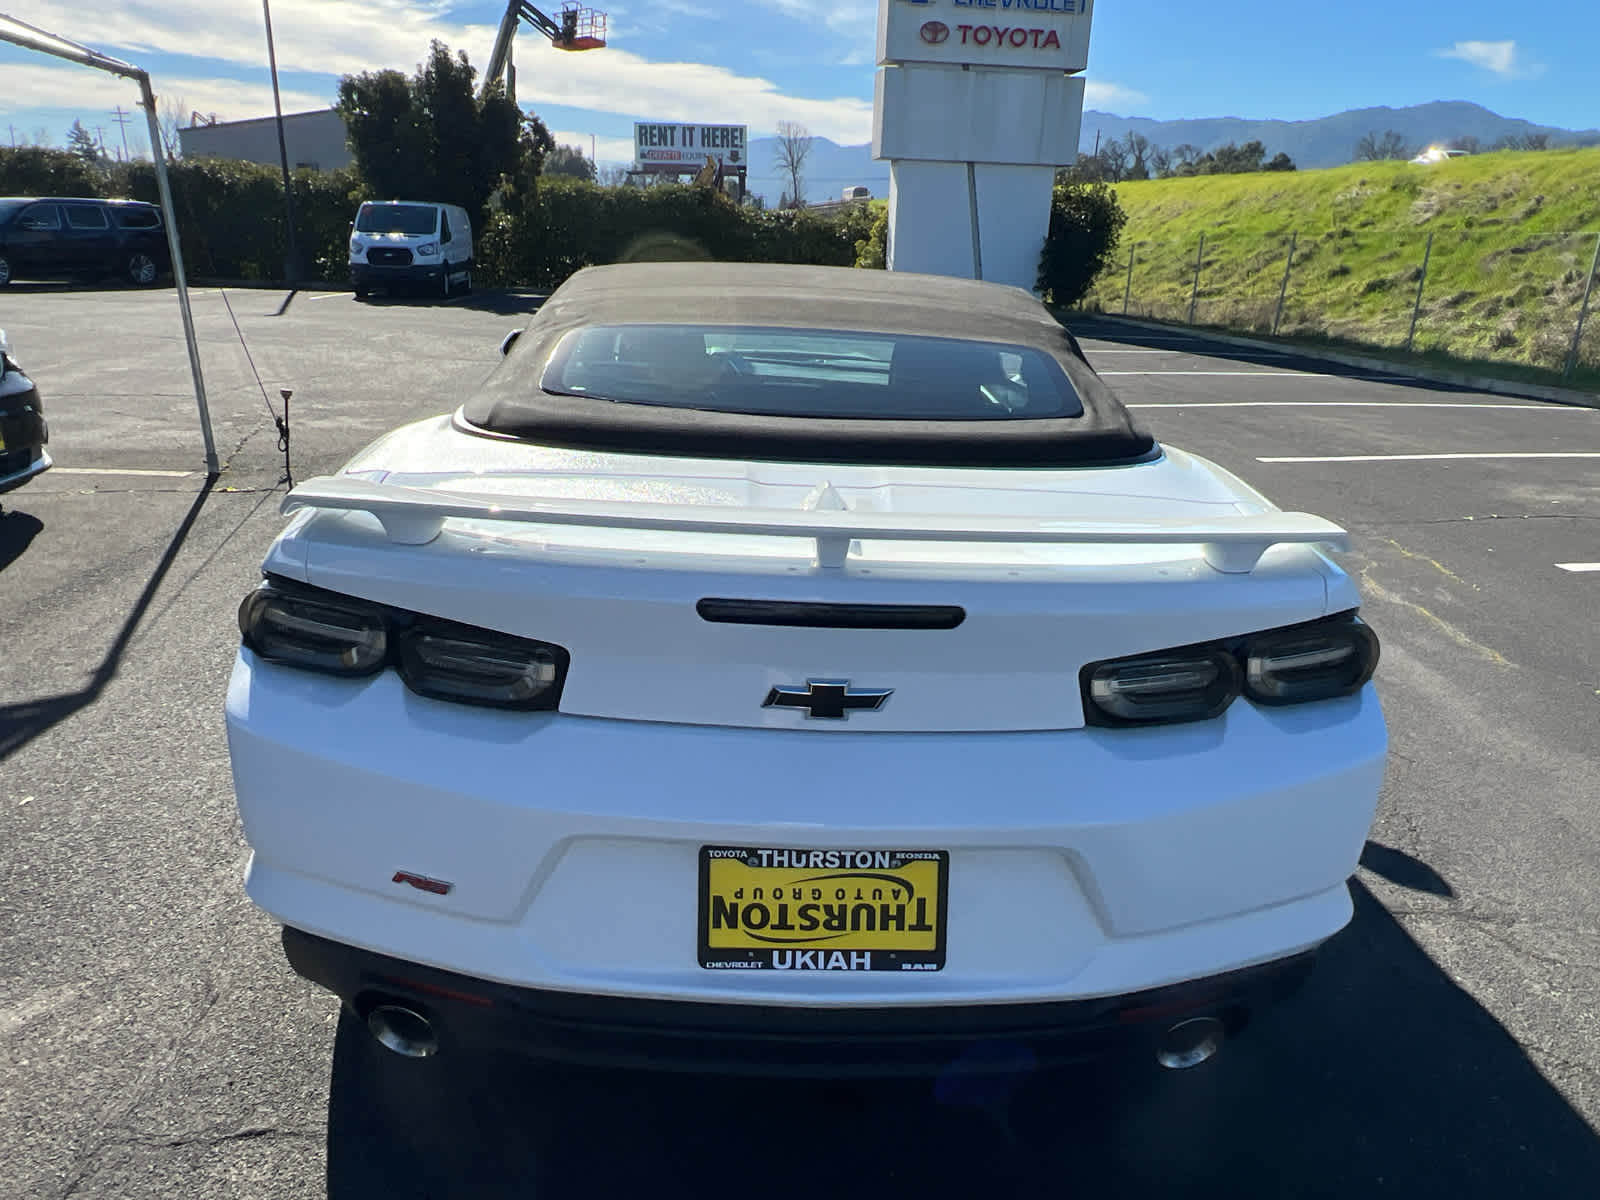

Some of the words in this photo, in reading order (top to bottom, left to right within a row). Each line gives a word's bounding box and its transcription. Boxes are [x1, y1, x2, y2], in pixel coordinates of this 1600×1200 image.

[957, 24, 1061, 49] TOYOTA
[639, 125, 676, 146] RENT
[681, 127, 695, 147] IT
[701, 128, 744, 148] HERE!
[709, 850, 748, 858] TOYOTA
[757, 850, 890, 868] THURSTON
[895, 852, 941, 860] HONDA
[734, 887, 821, 900] GROUP
[831, 888, 903, 900] AUTO
[712, 895, 932, 931] THURSTON
[706, 961, 763, 969] CHEVROLET
[772, 950, 871, 970] UKIAH
